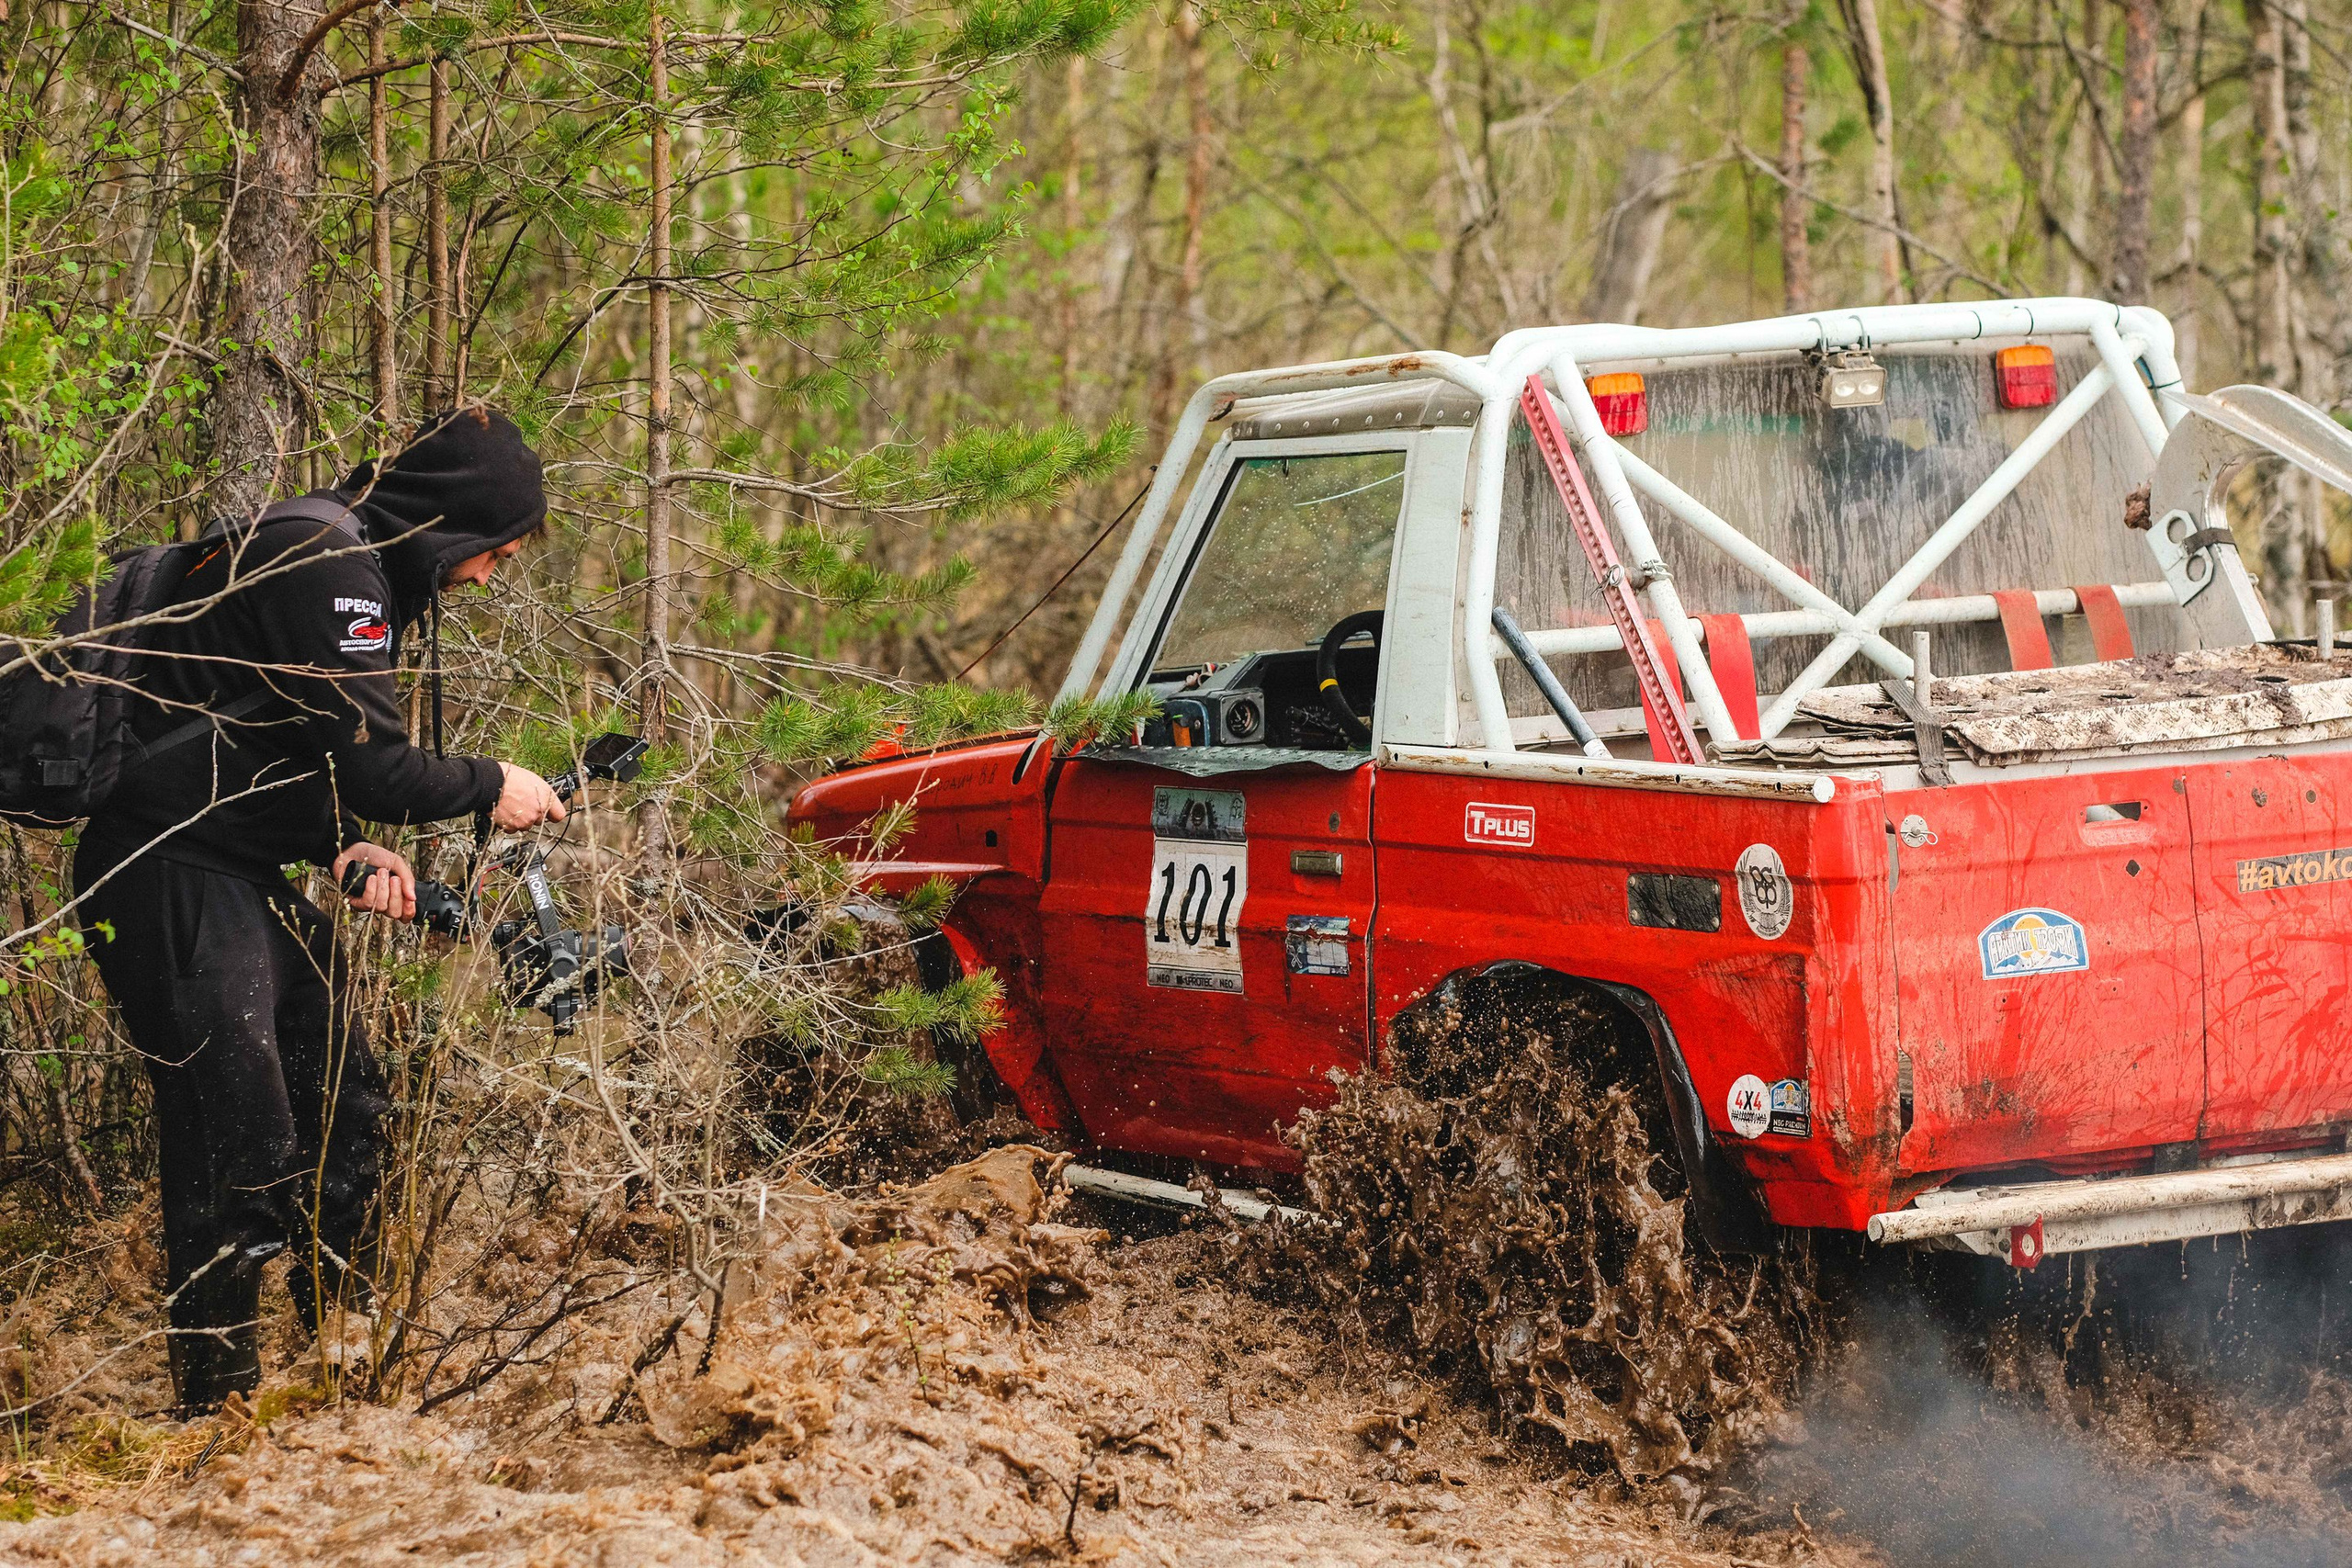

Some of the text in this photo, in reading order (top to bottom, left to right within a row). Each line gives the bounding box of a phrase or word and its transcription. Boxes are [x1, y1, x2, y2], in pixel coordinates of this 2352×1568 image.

[334, 597, 382, 617] ПРЕССА
[1470, 810, 1531, 839] TPLUS
[527, 873, 550, 910] RONIN
[1154, 861, 1237, 948] 101
[1157, 974, 1170, 984] NEO
[1219, 979, 1234, 989] NEO
